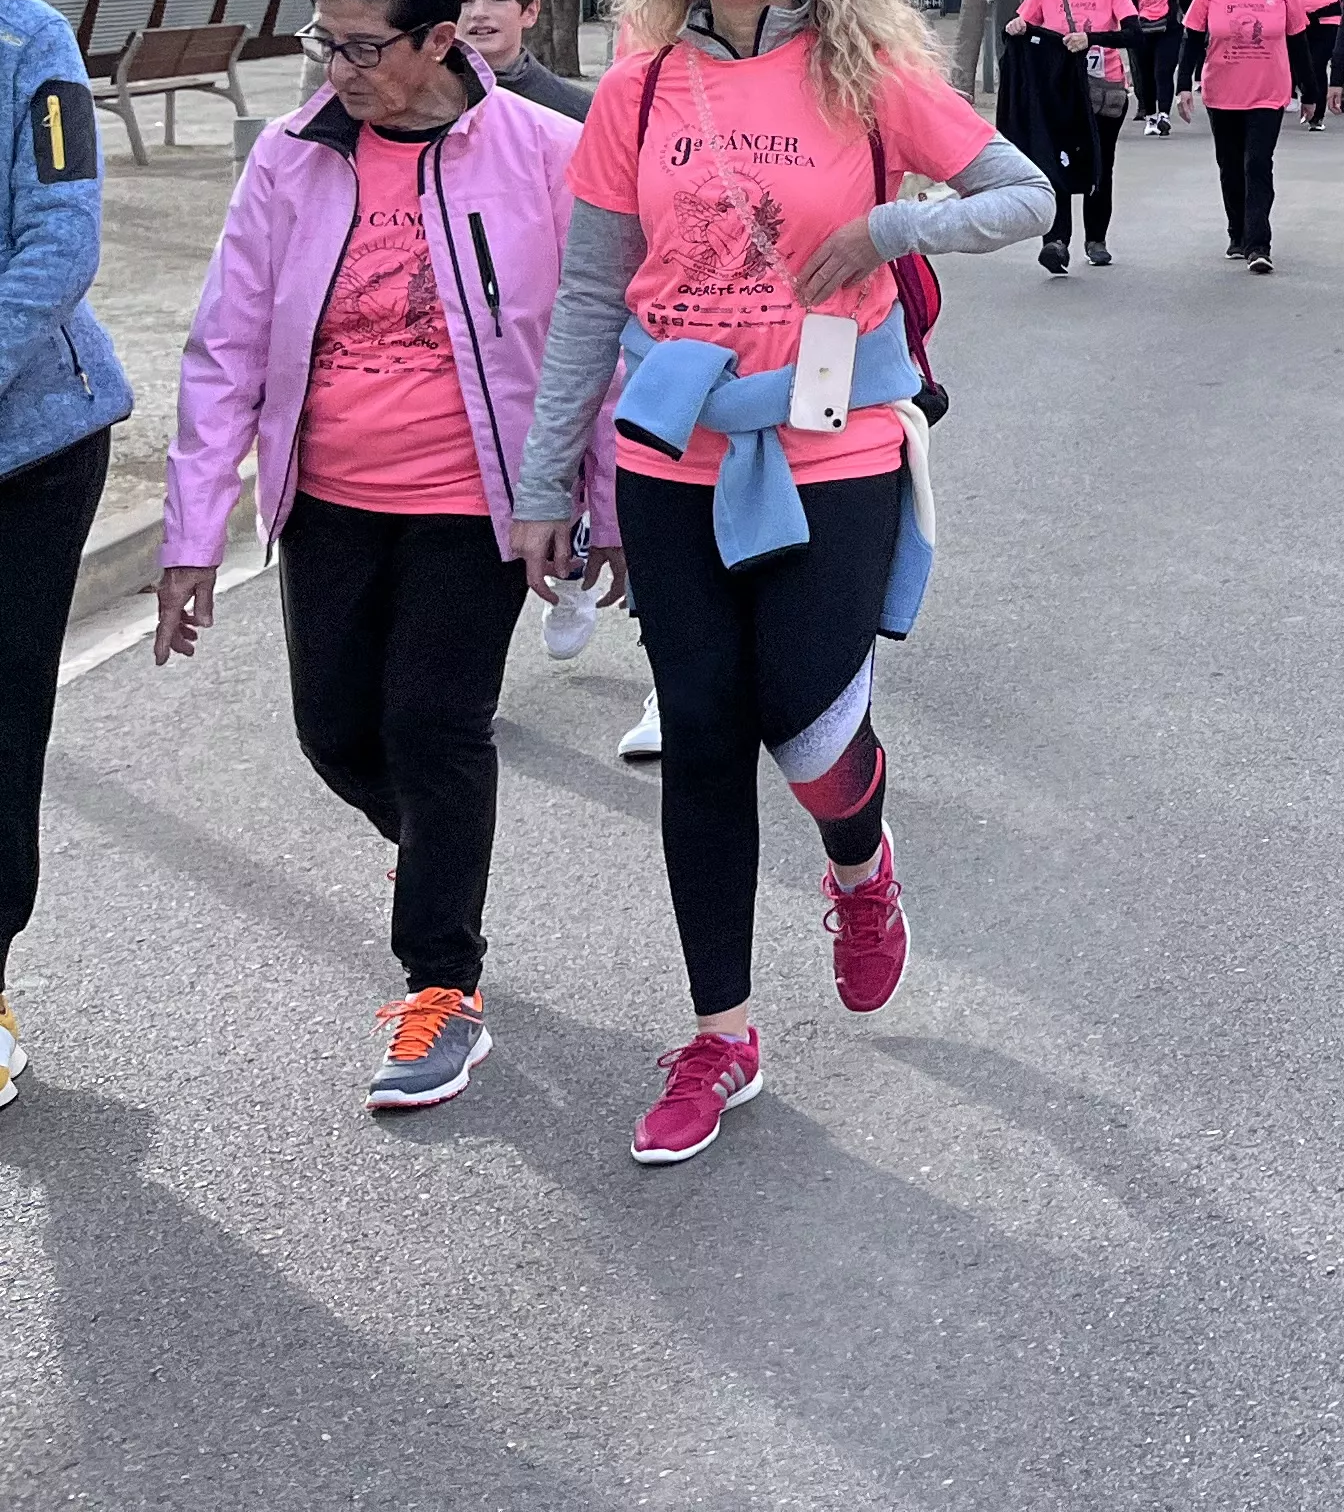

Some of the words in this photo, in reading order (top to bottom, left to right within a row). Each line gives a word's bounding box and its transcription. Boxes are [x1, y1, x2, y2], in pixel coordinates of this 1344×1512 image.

[710, 129, 799, 153] CÁNCER
[753, 152, 816, 168] HUESCA
[390, 335, 439, 350] MUCHO
